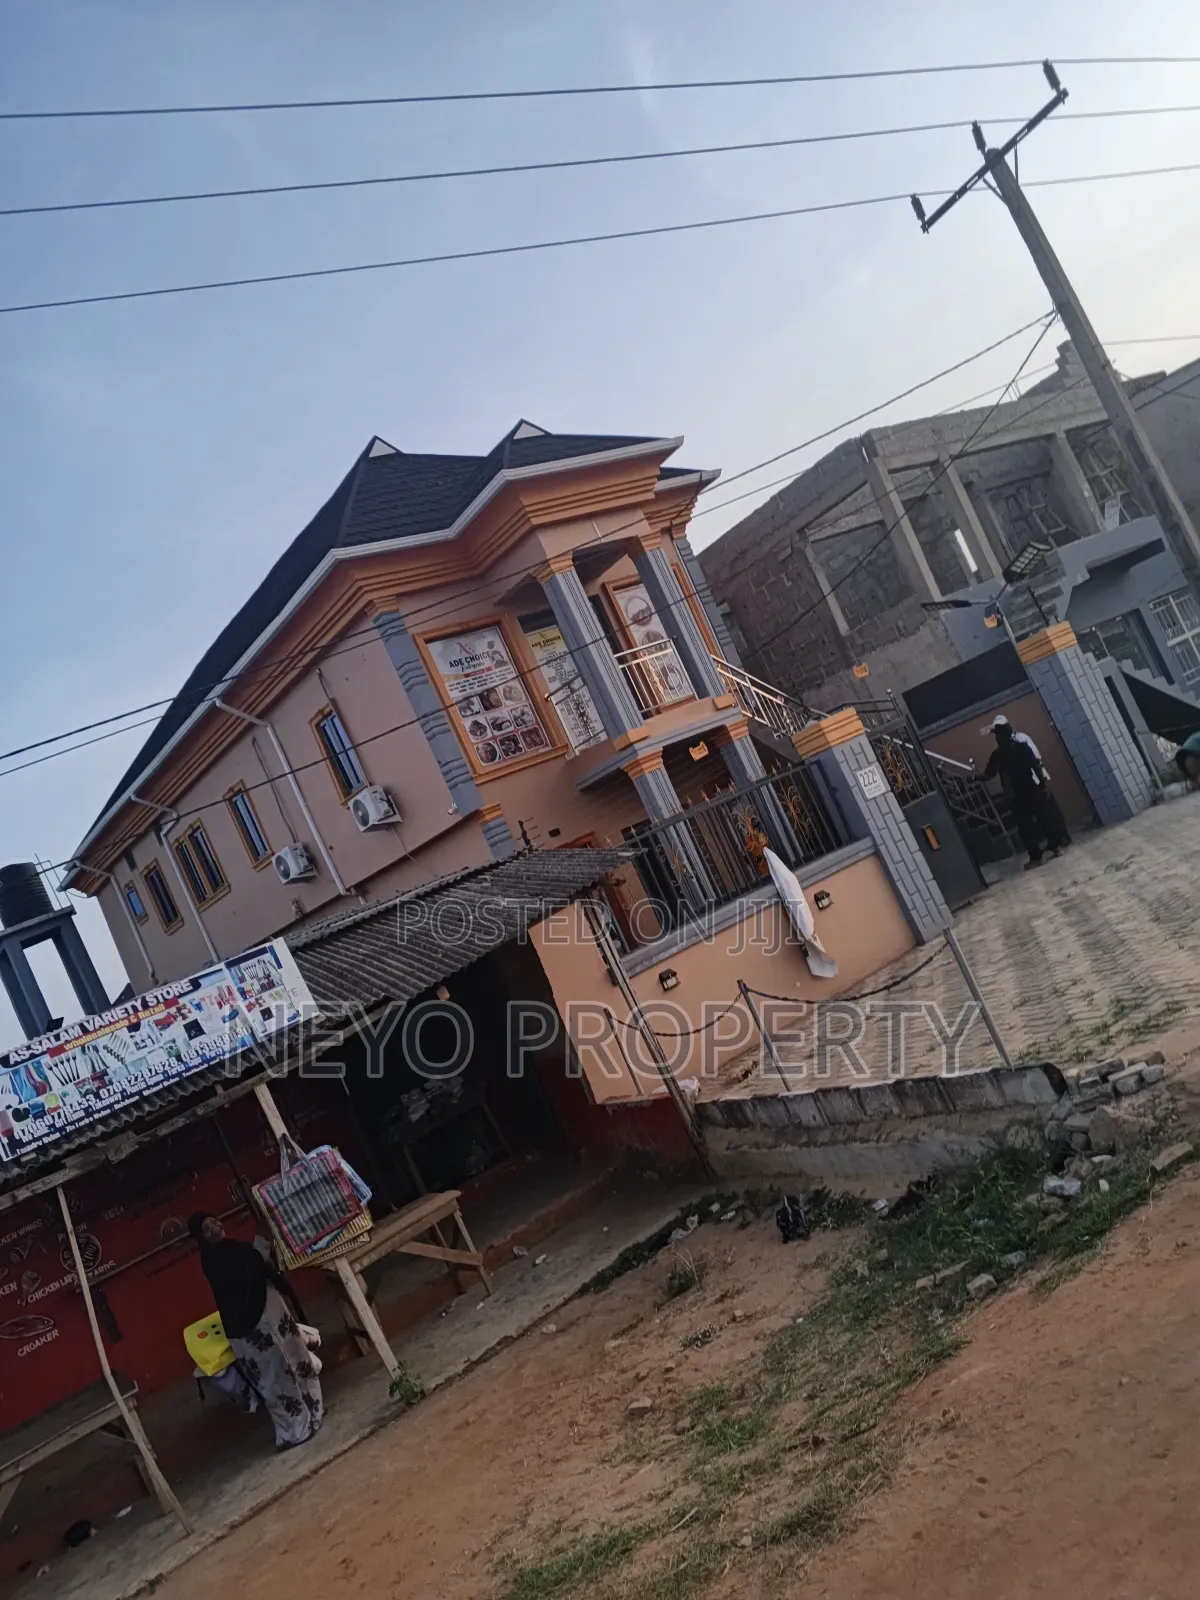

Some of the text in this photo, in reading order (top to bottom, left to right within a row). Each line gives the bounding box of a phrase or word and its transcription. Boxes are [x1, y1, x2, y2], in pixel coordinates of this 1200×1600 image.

[448, 650, 493, 669] ADE CHOICE
[82, 997, 143, 1032] VARIETY
[145, 979, 194, 1007] STORE
[18, 1218, 43, 1237] WINGS
[27, 1280, 60, 1304] CHICKEN
[17, 1329, 60, 1357] CROAKER
